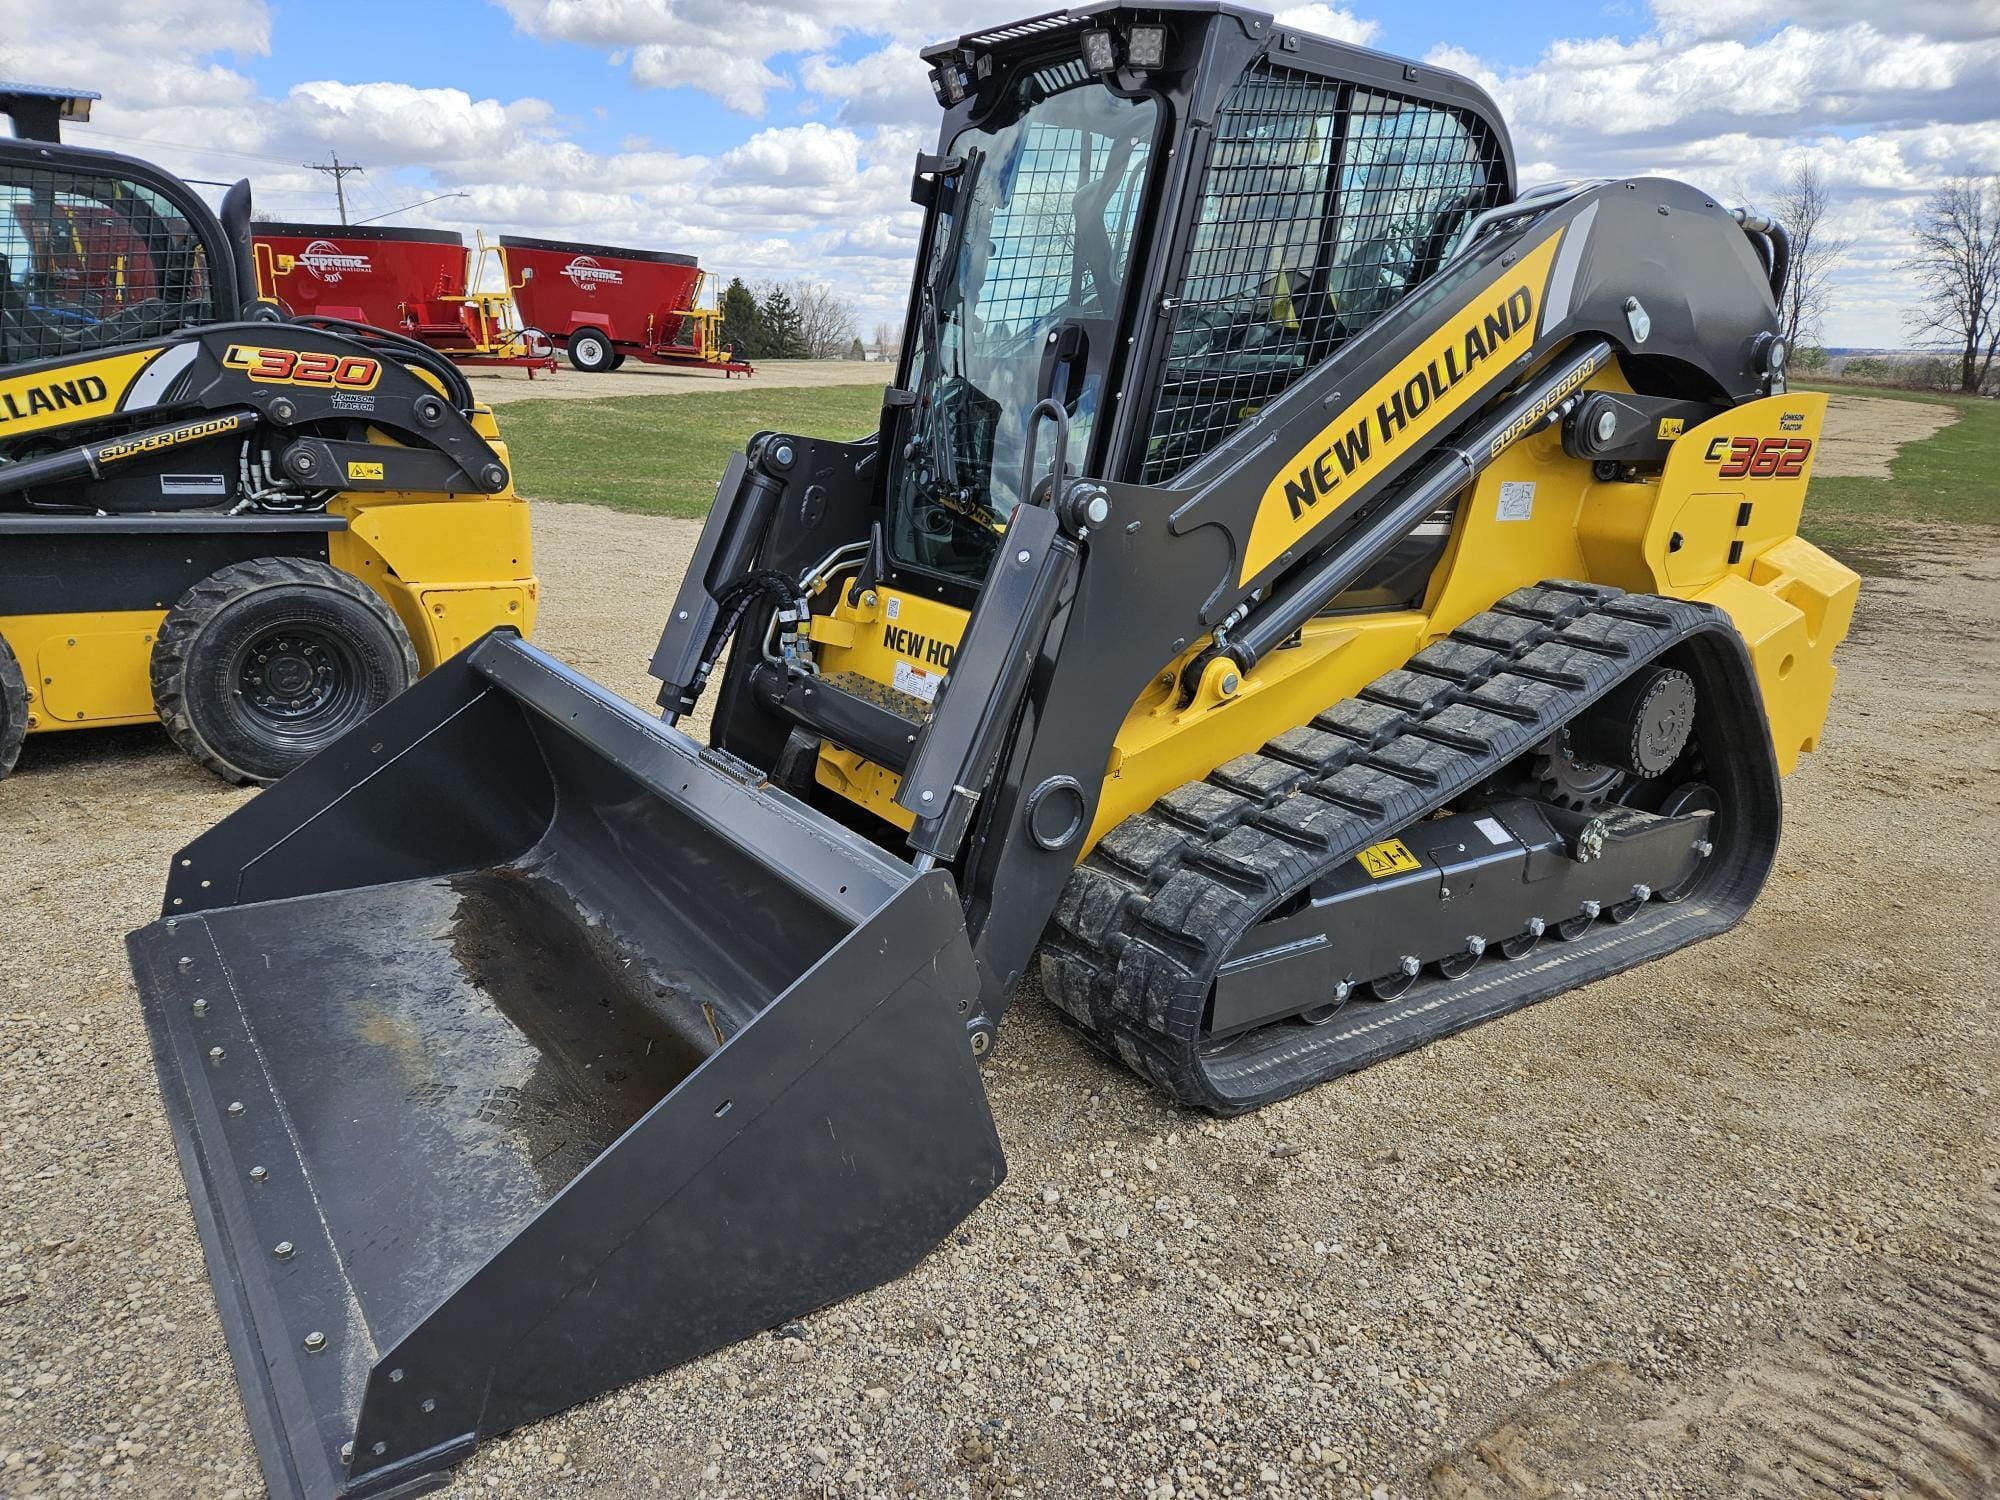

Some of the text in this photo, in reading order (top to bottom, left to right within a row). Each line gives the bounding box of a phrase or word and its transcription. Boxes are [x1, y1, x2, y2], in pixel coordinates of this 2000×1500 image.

[295, 253, 371, 271] Supreme
[560, 265, 623, 281] Supreme
[224, 346, 381, 390] L320
[331, 391, 376, 402] JOHNSON
[333, 400, 375, 411] TRACTOR
[1284, 285, 1533, 521] NEW HOLLAND
[1491, 357, 1595, 458] SUPER BOOM
[1779, 421, 1803, 431] TRACTOR
[1781, 411, 1805, 421] JOHNSON
[99, 415, 239, 463] SUPER BOOM
[1704, 436, 1813, 479] C362
[883, 624, 926, 659] NEW
